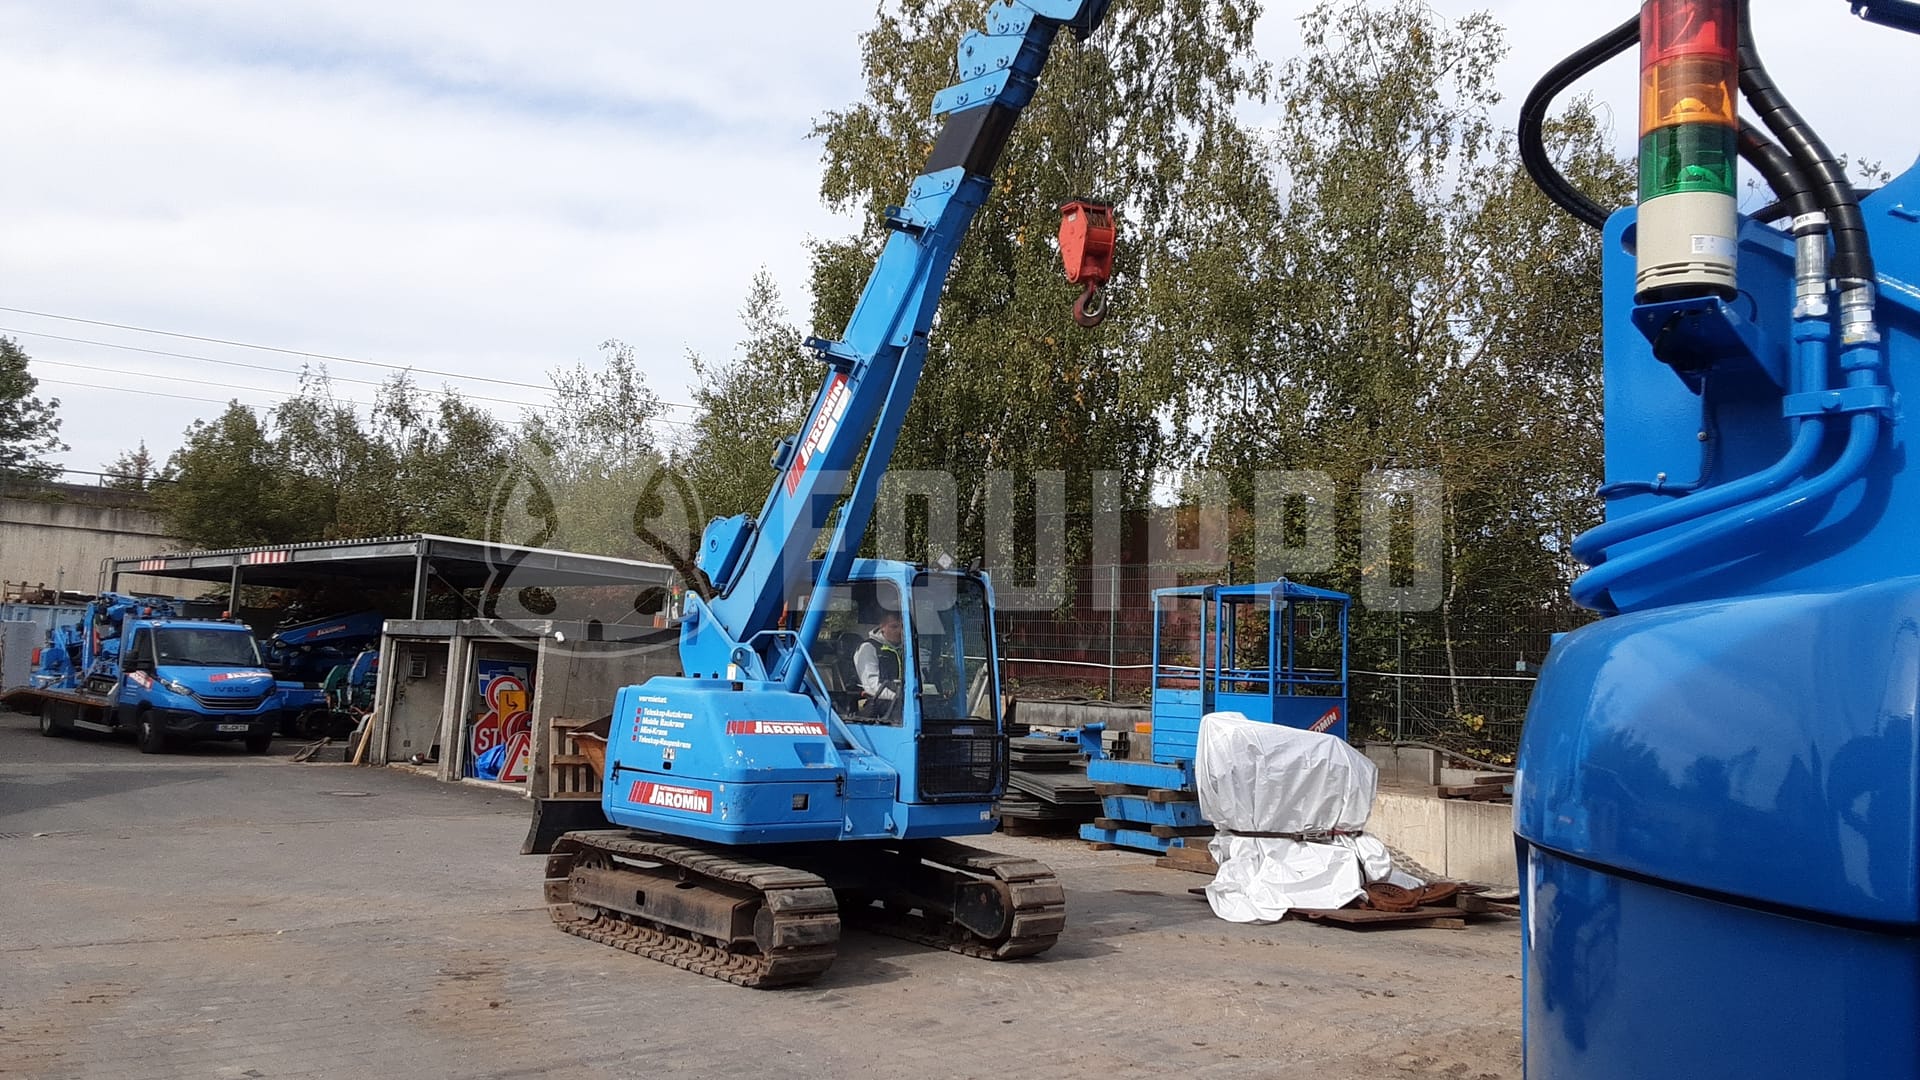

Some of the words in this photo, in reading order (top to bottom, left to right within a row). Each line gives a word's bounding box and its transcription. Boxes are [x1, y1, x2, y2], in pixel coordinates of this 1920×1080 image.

[799, 379, 845, 467] JAROMIN
[754, 720, 823, 735] JAROMIN
[648, 784, 709, 812] JAROMIN
